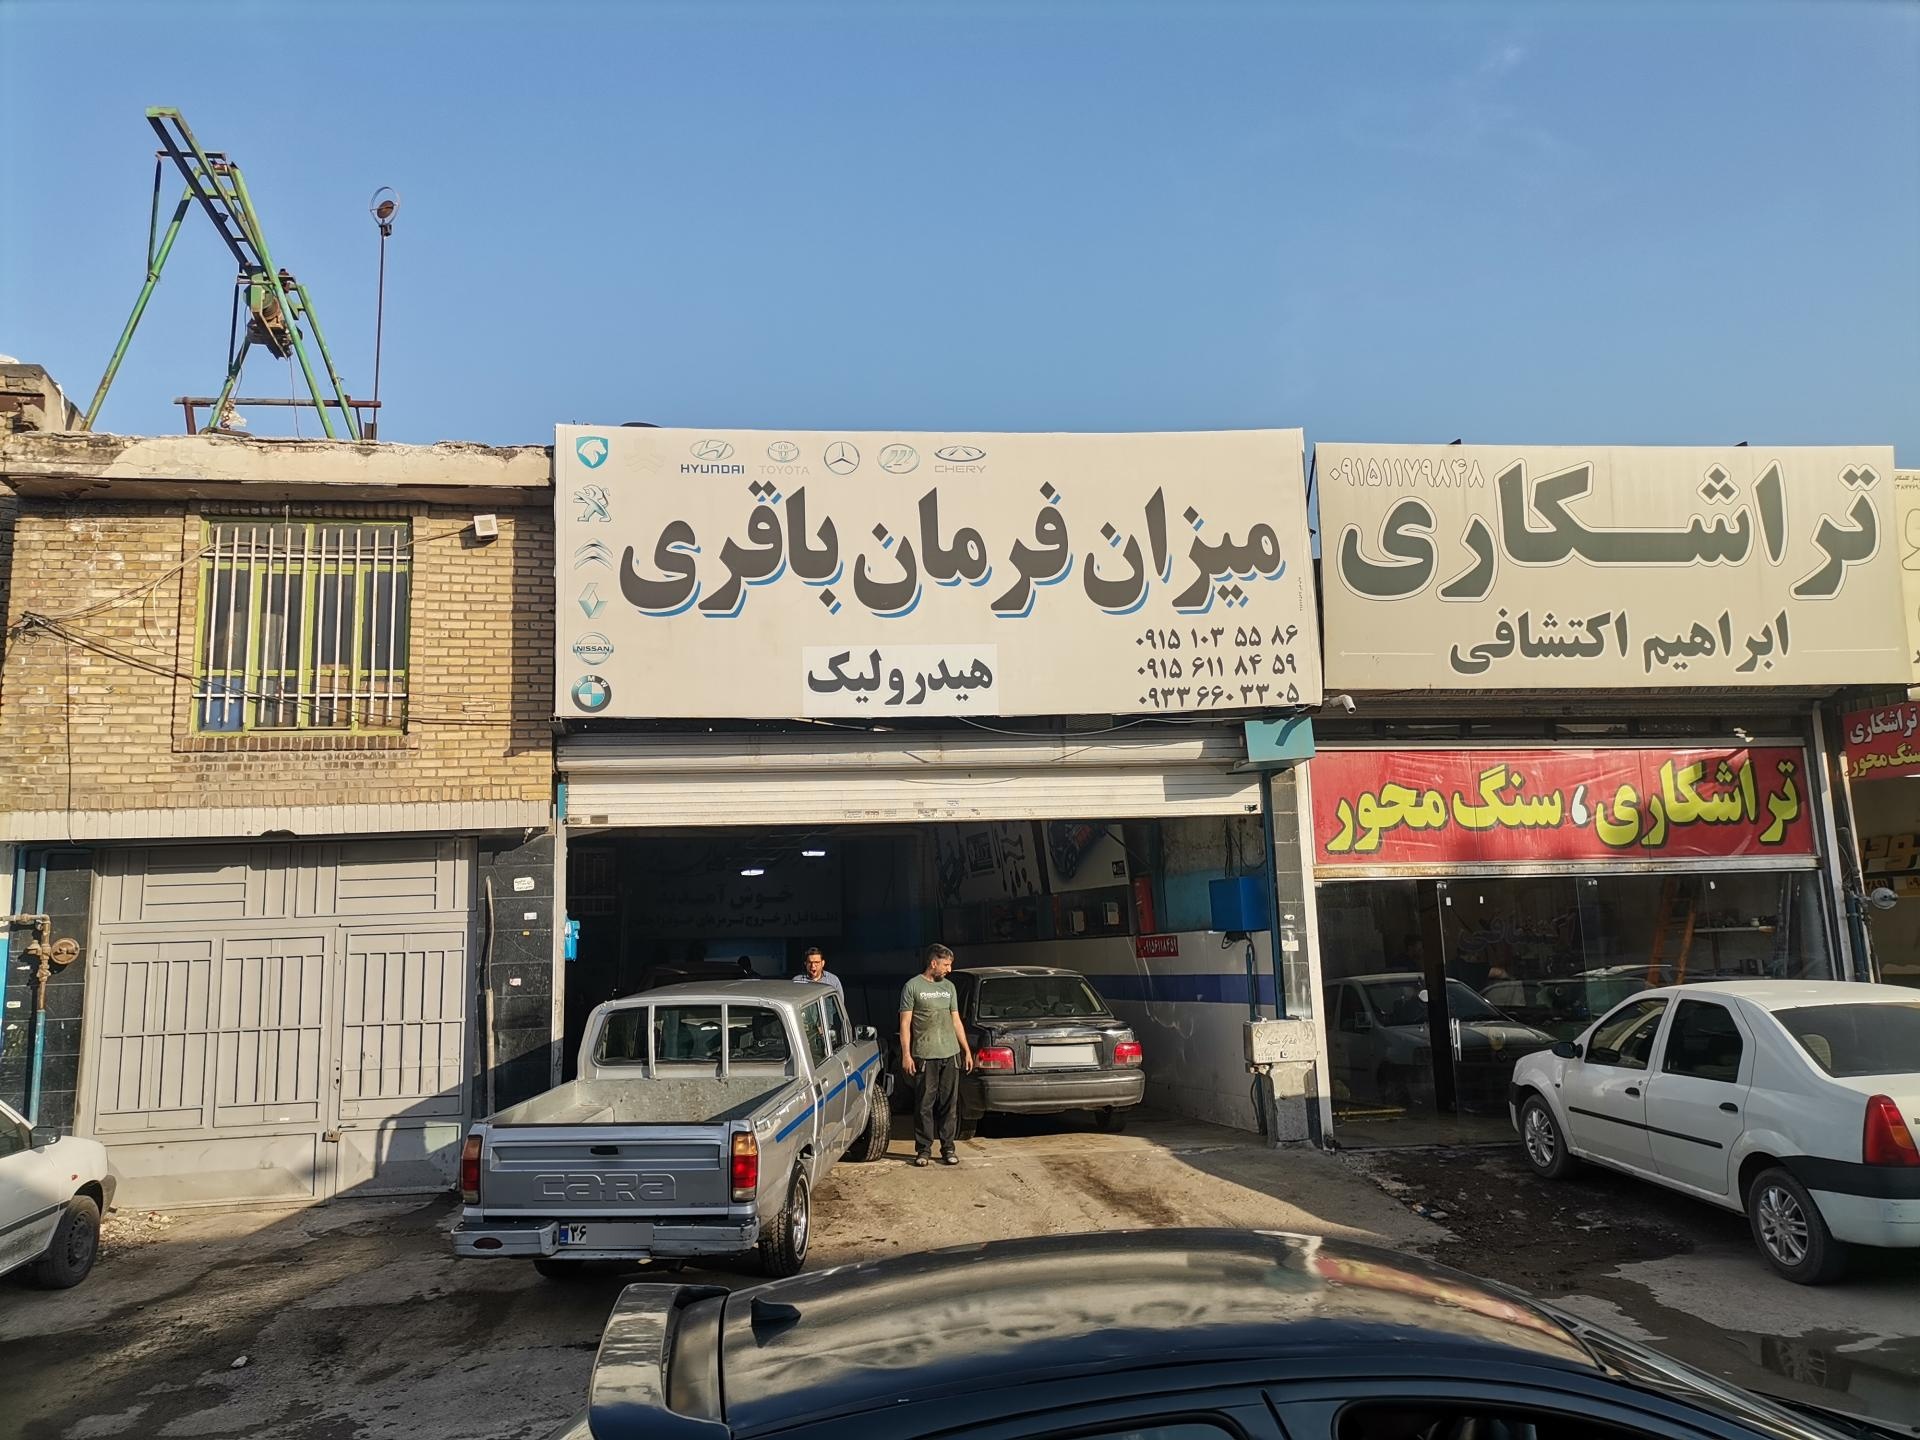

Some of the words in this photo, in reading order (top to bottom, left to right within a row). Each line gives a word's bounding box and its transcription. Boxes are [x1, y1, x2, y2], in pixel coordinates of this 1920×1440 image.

[680, 463, 745, 474] HYUNDAI
[759, 465, 810, 476] TOYOTA
[934, 465, 987, 473] CHERY
[1329, 457, 1485, 488] ۰۹۱۵۱۱۷۹۸۴۸
[619, 480, 844, 618] باقری
[853, 480, 1073, 618] فرمان
[1083, 485, 1286, 615] میزان
[1338, 459, 1881, 601] تراشکاری
[1135, 628, 1181, 650] ۰۹۱۵
[1190, 627, 1224, 649] ۱۰۳
[1234, 626, 1262, 647] ۵۵
[1271, 624, 1298, 645] ۸۶
[1450, 608, 1629, 675] اکتشافی
[1642, 609, 1790, 674] ابراهیم
[807, 648, 993, 706] هیدرولیک
[1137, 657, 1183, 679] ۰۹۱۵
[1192, 656, 1224, 678] ۶۱۱
[1234, 654, 1263, 676] ۸۴
[1272, 653, 1297, 675] ۵۹
[1138, 686, 1191, 708] ۰۹۳۳
[1197, 685, 1234, 707] ۶۶۰
[1239, 683, 1270, 705] ۳۳
[1276, 682, 1300, 704] ۰۵
[1849, 707, 1918, 744] تراشکاری
[1850, 752, 1888, 778] محور
[1325, 780, 1449, 855] محور
[1451, 763, 1564, 830] سنگ
